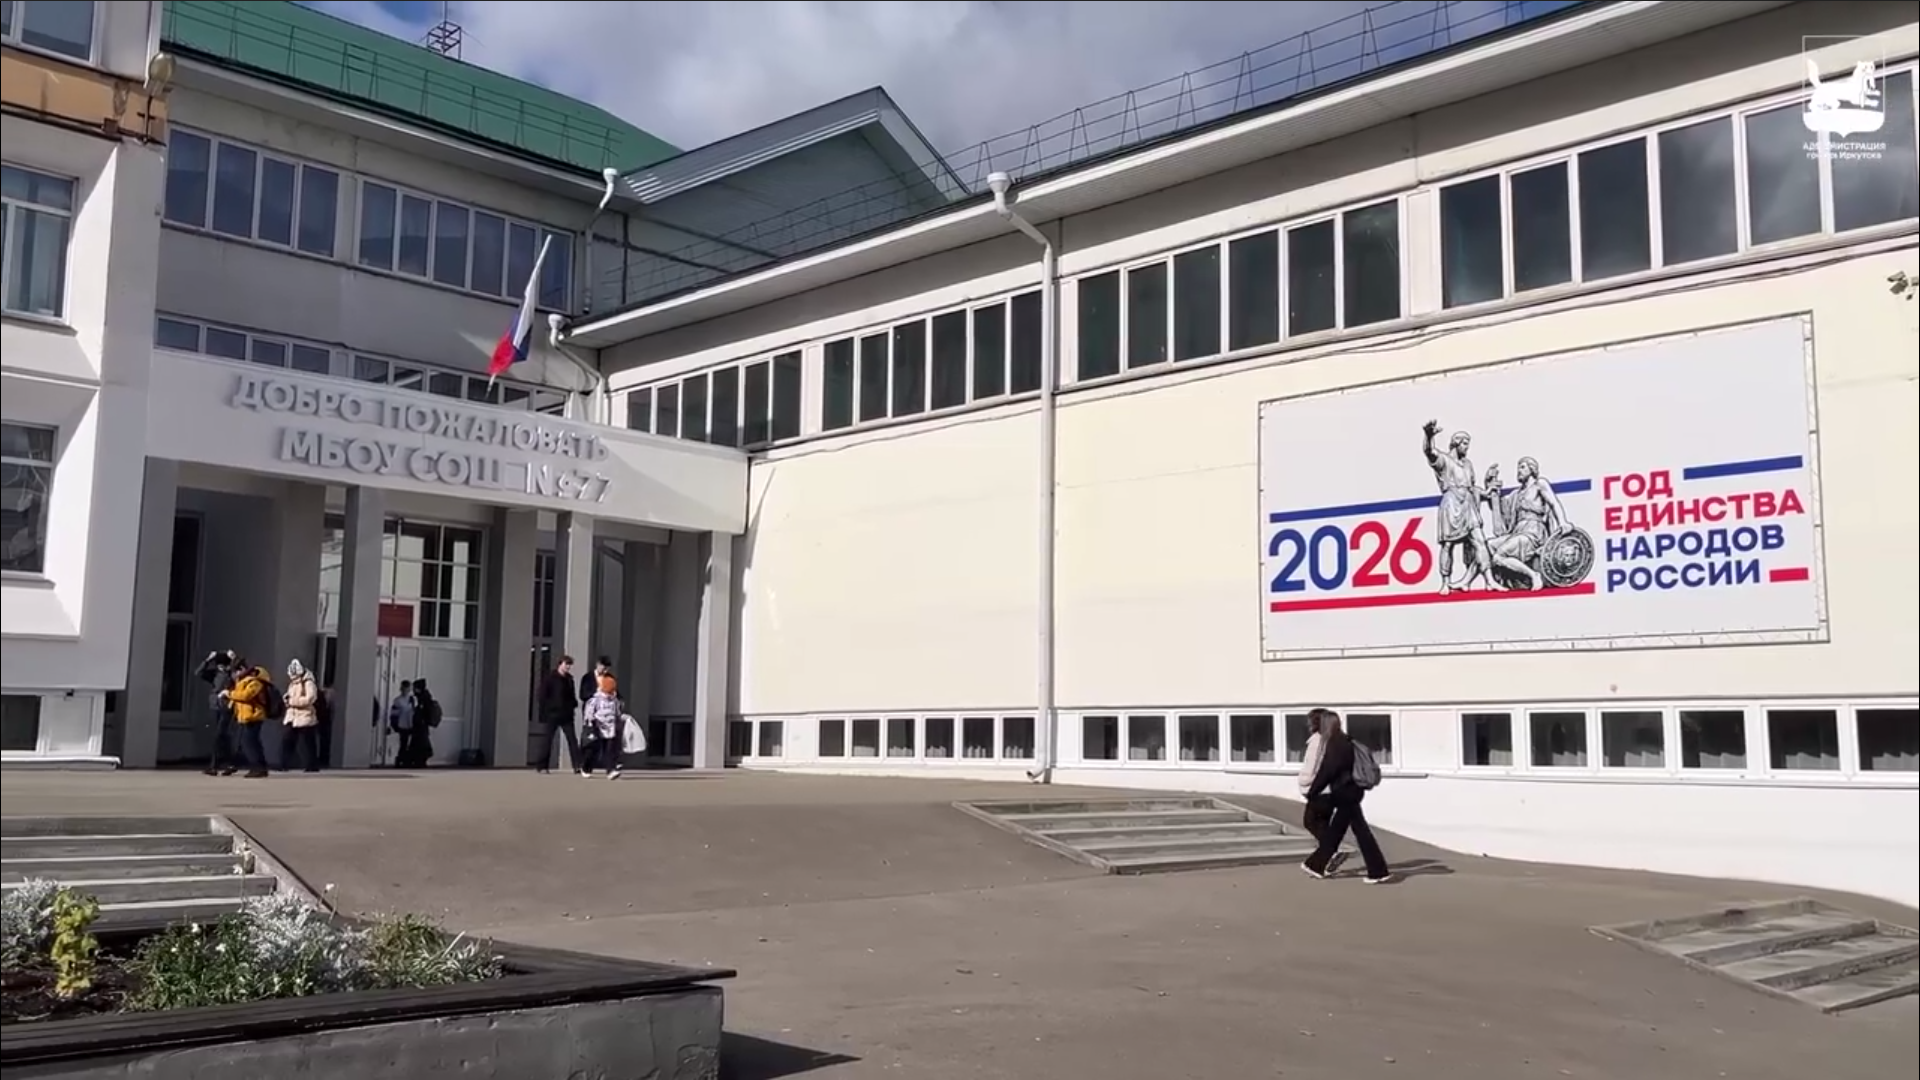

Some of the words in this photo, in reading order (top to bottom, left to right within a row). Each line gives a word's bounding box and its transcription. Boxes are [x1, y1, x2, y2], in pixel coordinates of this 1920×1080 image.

[231, 375, 363, 423] ДОБРО
[381, 404, 610, 460] ПОЖАЛОВАТЬ
[280, 427, 399, 474] МБОУ
[409, 447, 500, 486] СОШ
[1603, 470, 1673, 499] ГОД
[1604, 490, 1804, 532] ЕДИНСТВА
[1269, 517, 1433, 592] 2026
[1606, 525, 1784, 561] НАРОДОВ
[1608, 559, 1760, 592] РОССИИ
